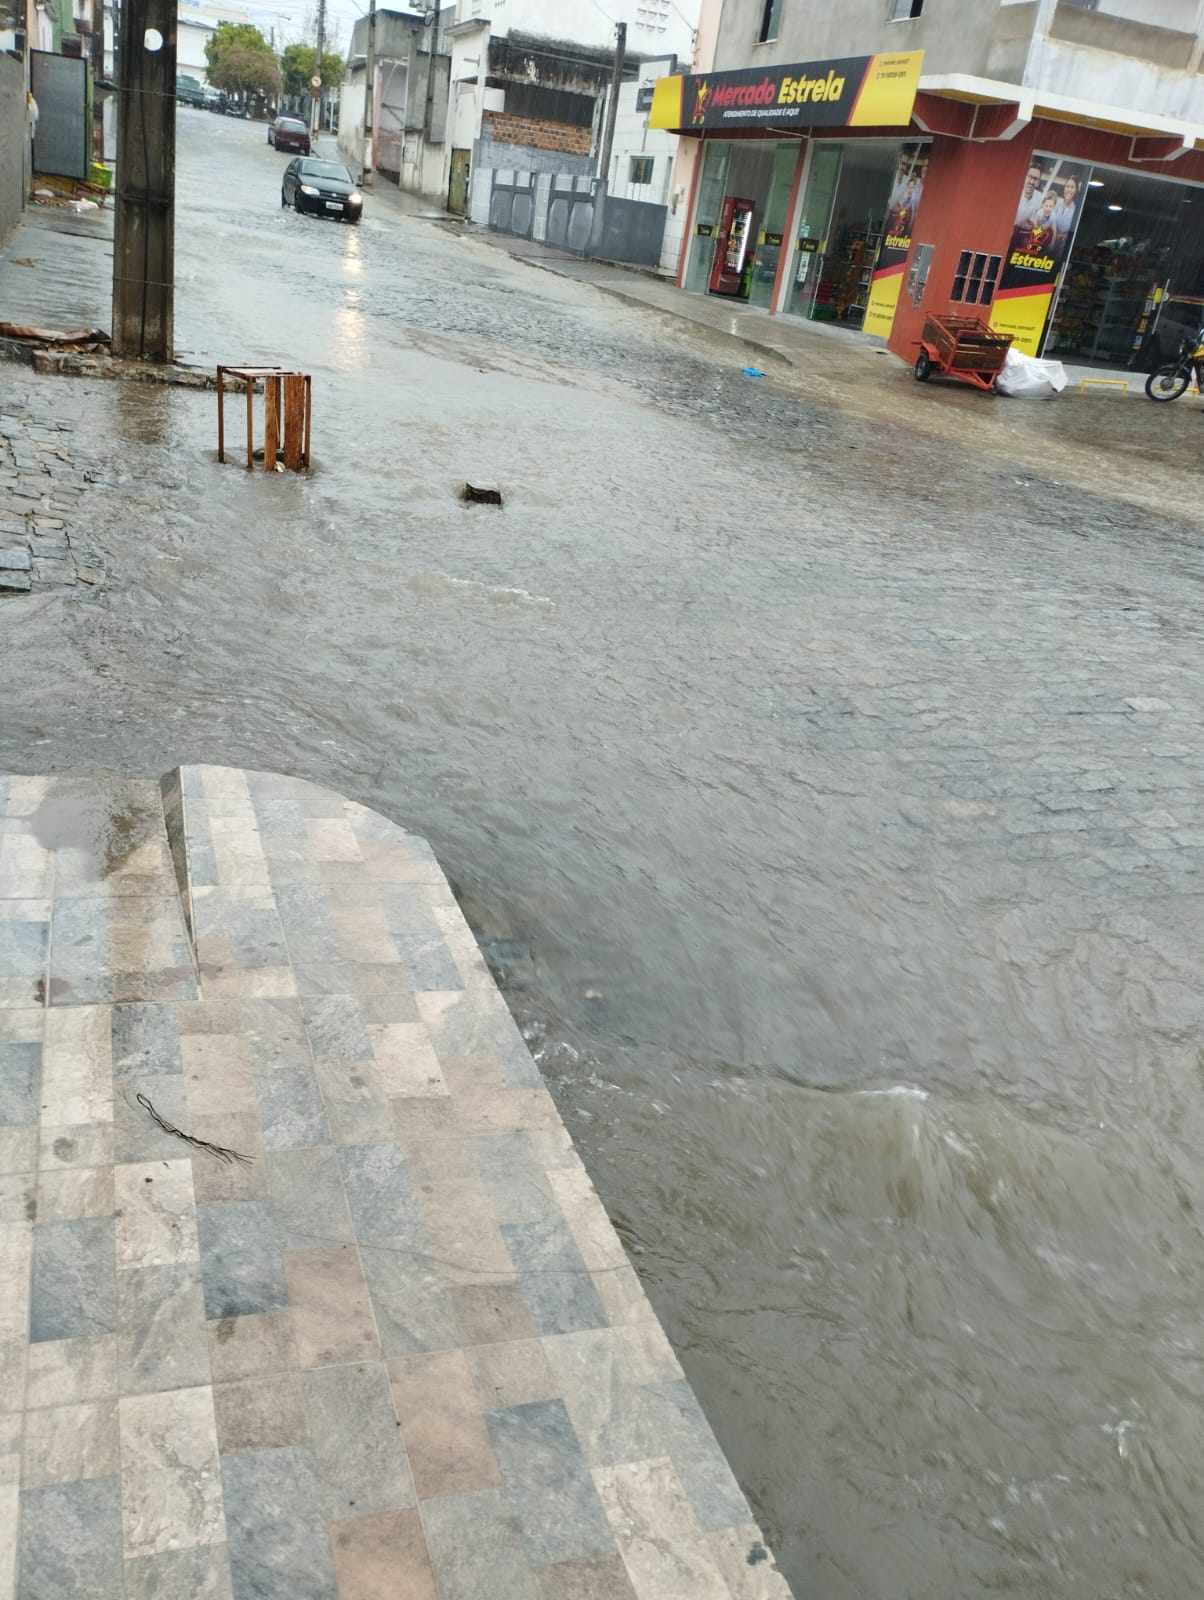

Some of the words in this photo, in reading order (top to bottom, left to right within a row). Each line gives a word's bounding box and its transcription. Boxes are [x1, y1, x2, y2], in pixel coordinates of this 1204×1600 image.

[712, 78, 776, 106] Mercado
[777, 70, 845, 104] Estrela
[884, 234, 911, 249] Estrela
[1010, 251, 1055, 270] Estrela
